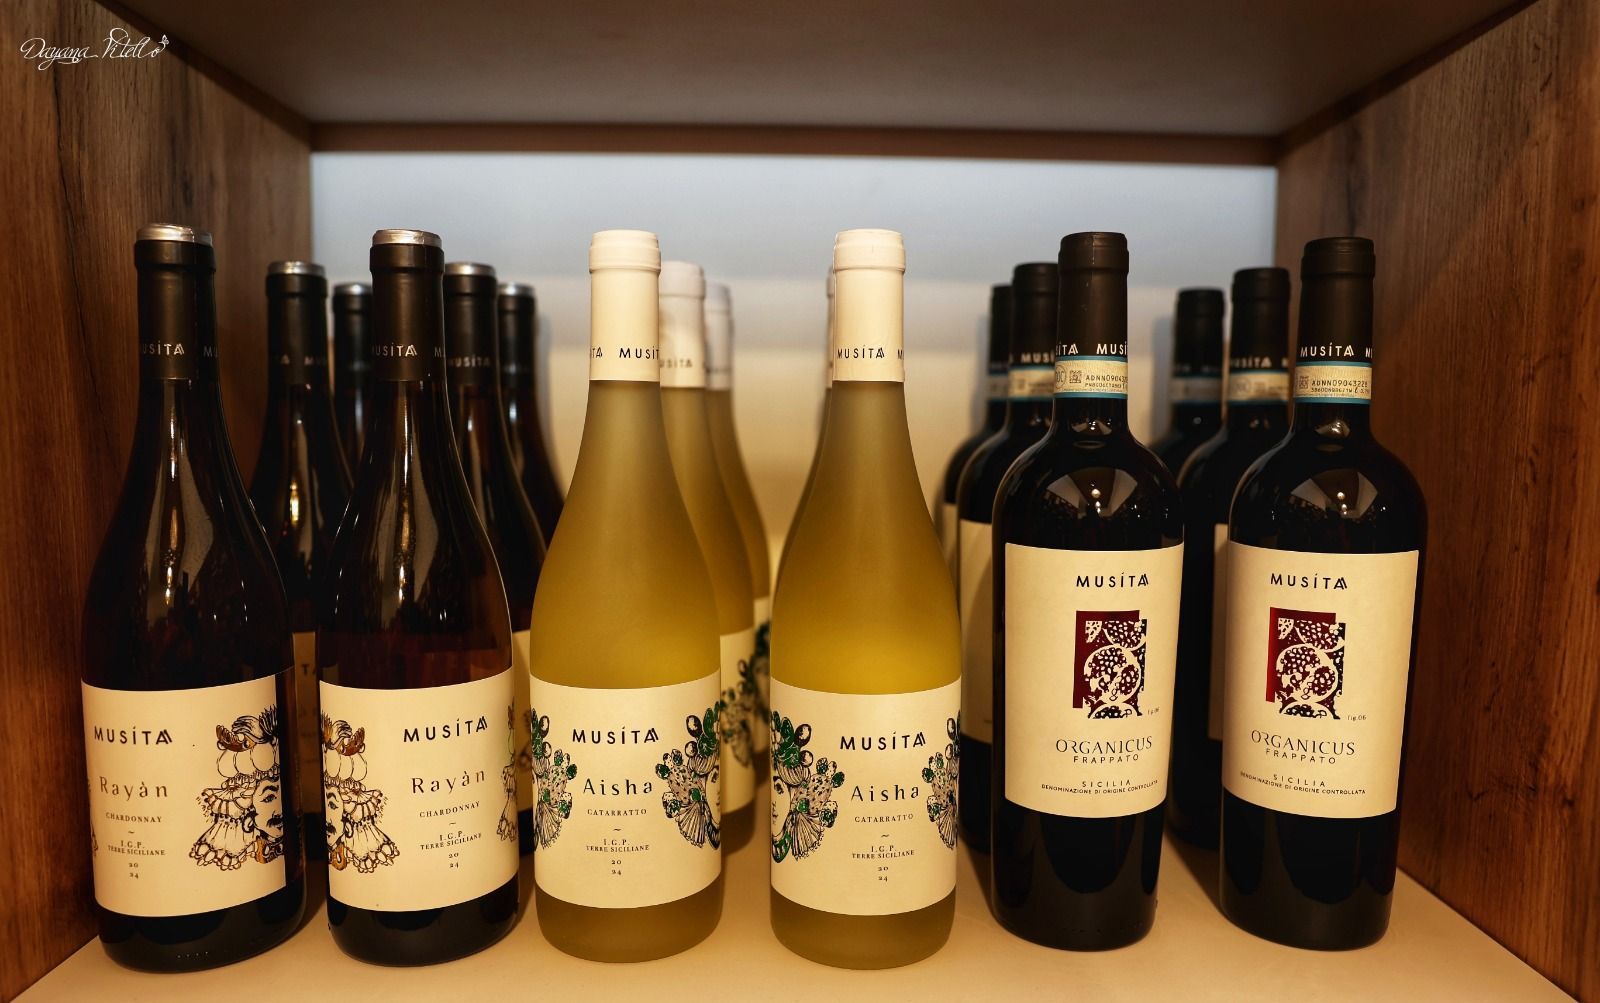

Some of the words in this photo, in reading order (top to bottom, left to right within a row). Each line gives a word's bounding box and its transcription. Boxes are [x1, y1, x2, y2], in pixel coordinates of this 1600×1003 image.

[1055, 735, 1153, 754] ORGANICUS
[1251, 729, 1355, 756] ORGANICUS
[1073, 753, 1139, 764] FRAPPATO
[1265, 748, 1336, 765] FRAPPATO
[99, 776, 168, 801] Rayàn
[411, 770, 485, 794] Rayàn
[583, 778, 653, 796] Aisha
[1041, 783, 1092, 794] DENOMINAZIONE
[1082, 779, 1131, 788] SICILIA
[1240, 770, 1282, 789] DENOMINAZIONE
[1293, 784, 1320, 794] ORIGINE
[1273, 774, 1326, 788] SICILIA
[850, 784, 919, 802] Aisha
[419, 801, 480, 818] CHARDONNAY
[587, 808, 647, 817] CATARRATTO
[105, 812, 162, 823] CHARDONNAY
[854, 813, 914, 823] CATARRATTO
[420, 841, 444, 850] TERRE
[446, 833, 482, 847] SICILIANE
[610, 844, 650, 853] SICILIANE
[108, 845, 125, 854] TERRE
[851, 852, 875, 860] TERRE
[877, 849, 915, 859] SICILIANE
